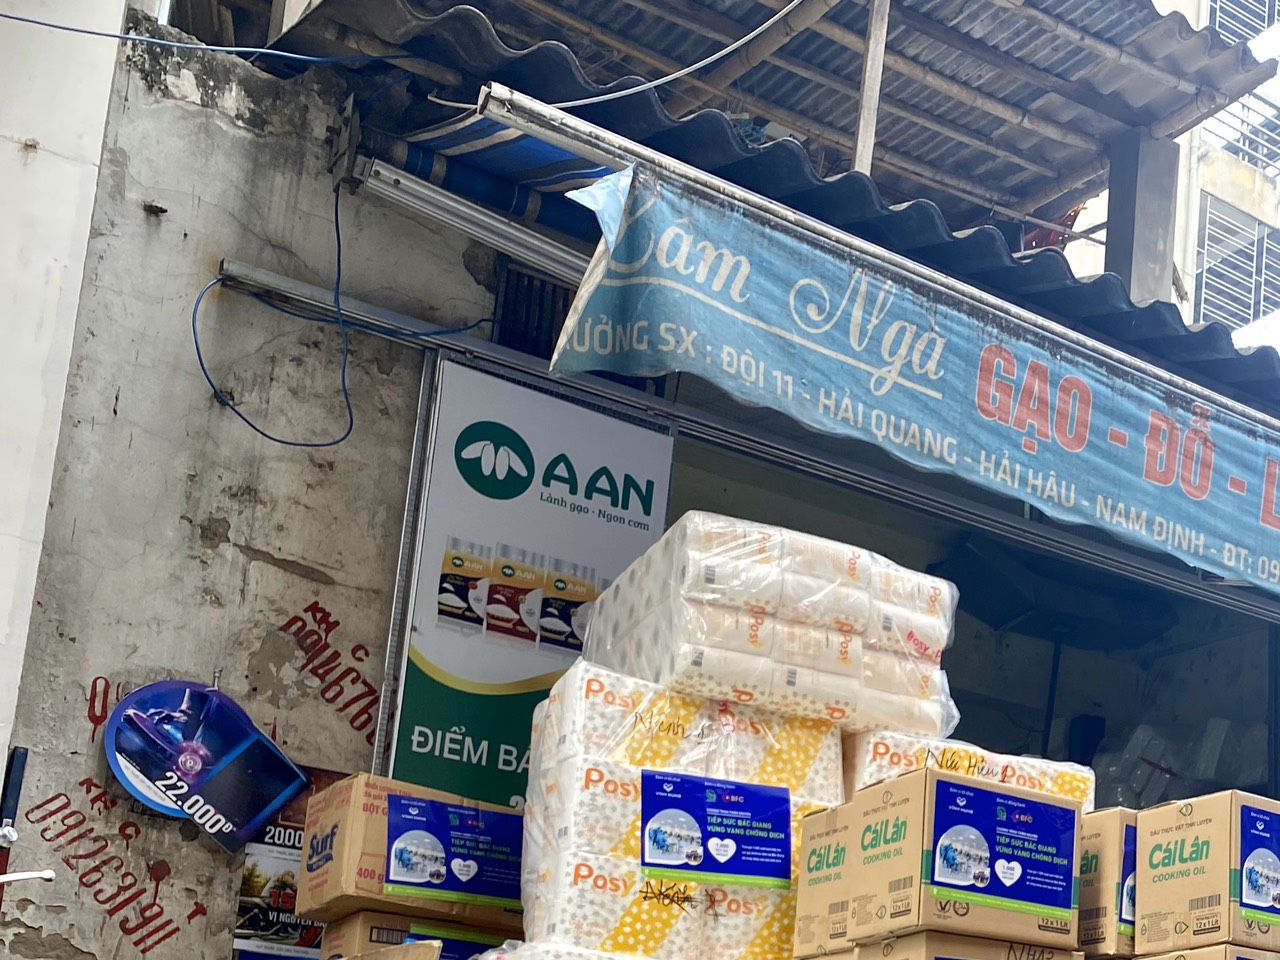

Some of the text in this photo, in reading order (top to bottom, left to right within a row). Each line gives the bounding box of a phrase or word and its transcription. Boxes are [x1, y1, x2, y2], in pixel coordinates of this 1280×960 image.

[788, 269, 945, 397] Ngà
[567, 316, 649, 355] ƯỞNG
[658, 323, 697, 358] SX
[721, 343, 766, 388] ĐỘI
[776, 371, 794, 400] 11
[818, 386, 863, 428] HẢI
[870, 408, 957, 465] QUANG
[979, 443, 1020, 490] HẢI
[1027, 468, 1076, 508] HẬU
[1095, 493, 1149, 535] NAM
[1151, 511, 1204, 558] ĐỊNH
[974, 342, 1092, 454] GẠO
[1143, 402, 1215, 500] ĐỖ
[541, 452, 654, 517] AAN
[539, 492, 650, 531] Lành gạo Ngon cơm
[411, 724, 529, 774] ĐIỂM BÁ
[308, 824, 339, 860] Surf
[862, 847, 903, 865] COOKING OIL
[357, 867, 376, 880] 400
[1152, 865, 1206, 884] COOKING OIL
